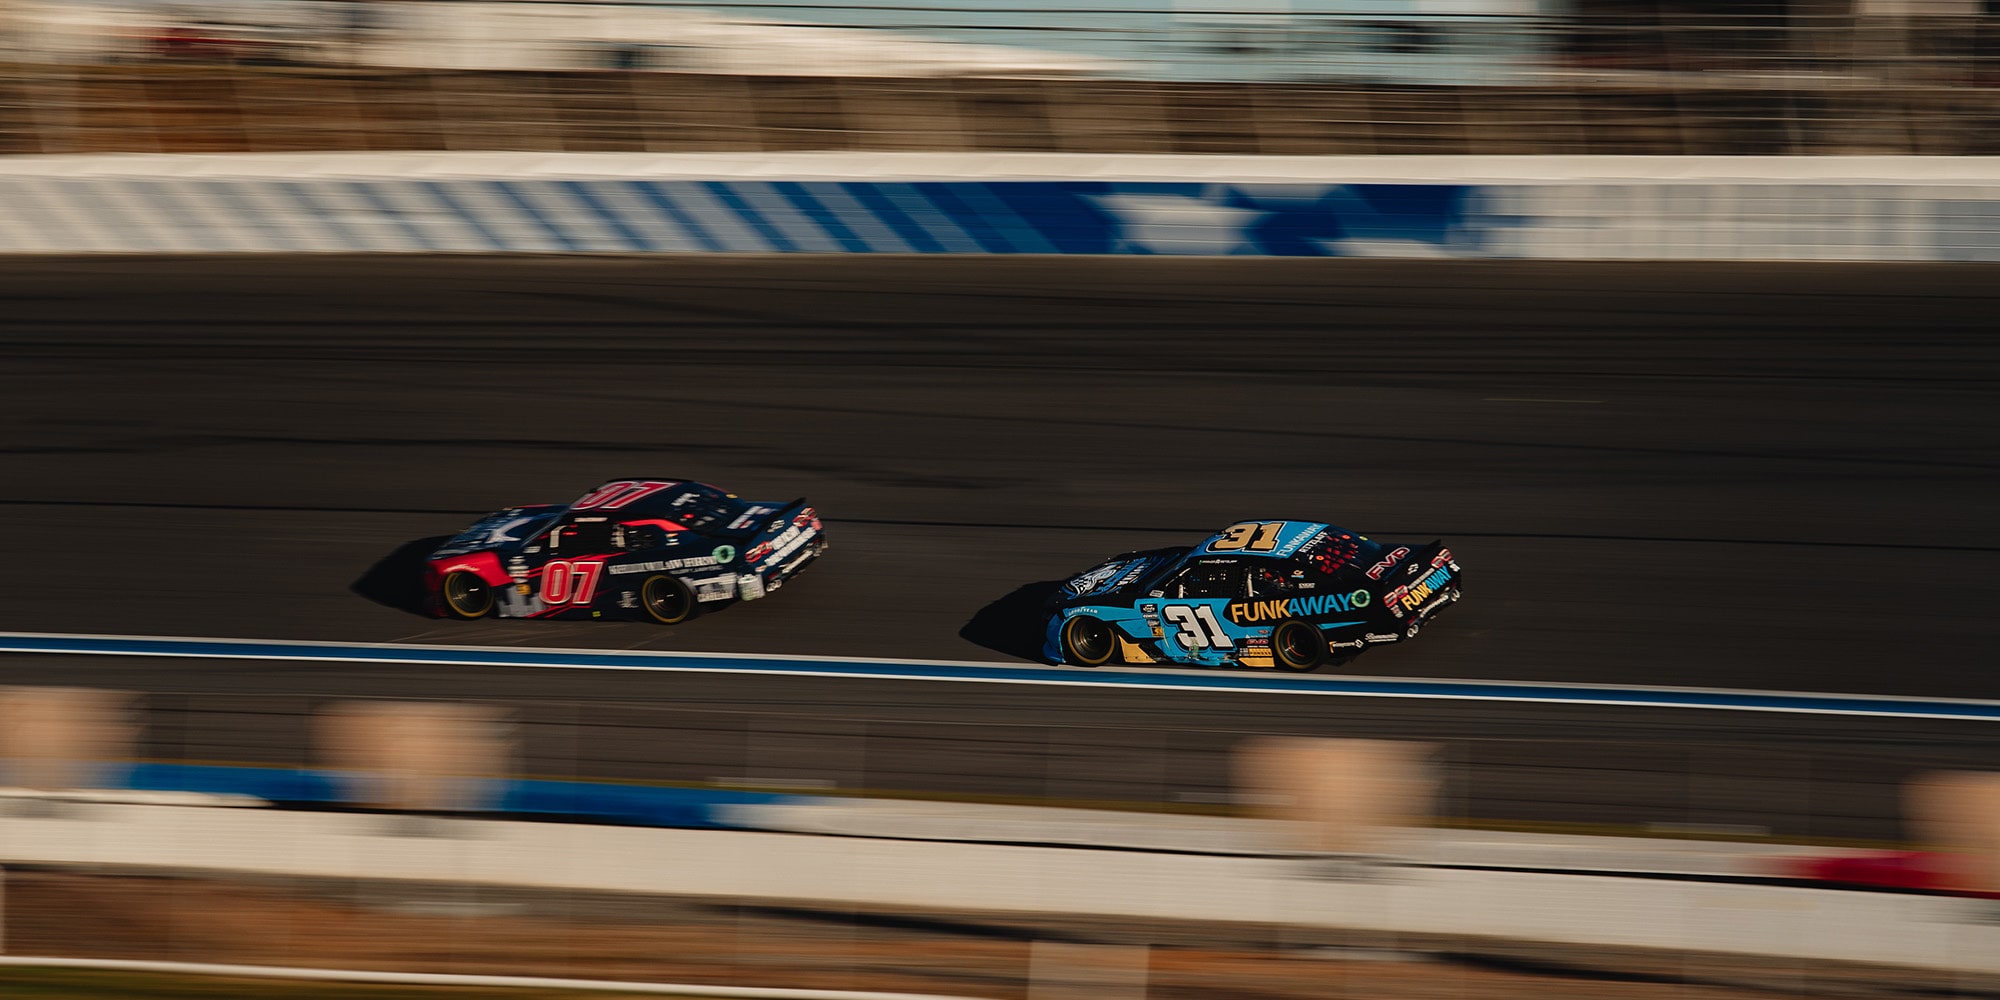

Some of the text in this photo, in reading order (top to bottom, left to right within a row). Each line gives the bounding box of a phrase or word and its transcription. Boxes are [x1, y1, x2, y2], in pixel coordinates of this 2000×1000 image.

[570, 481, 677, 510] 07
[1211, 522, 1284, 550] 31
[1276, 523, 1322, 557] FUNKAWAY
[1365, 546, 1410, 580] FVP
[540, 561, 604, 604] 07
[1400, 564, 1452, 611] FUNKAWAY
[1231, 593, 1354, 623] FUNKAWAY
[1164, 605, 1234, 648] 31
